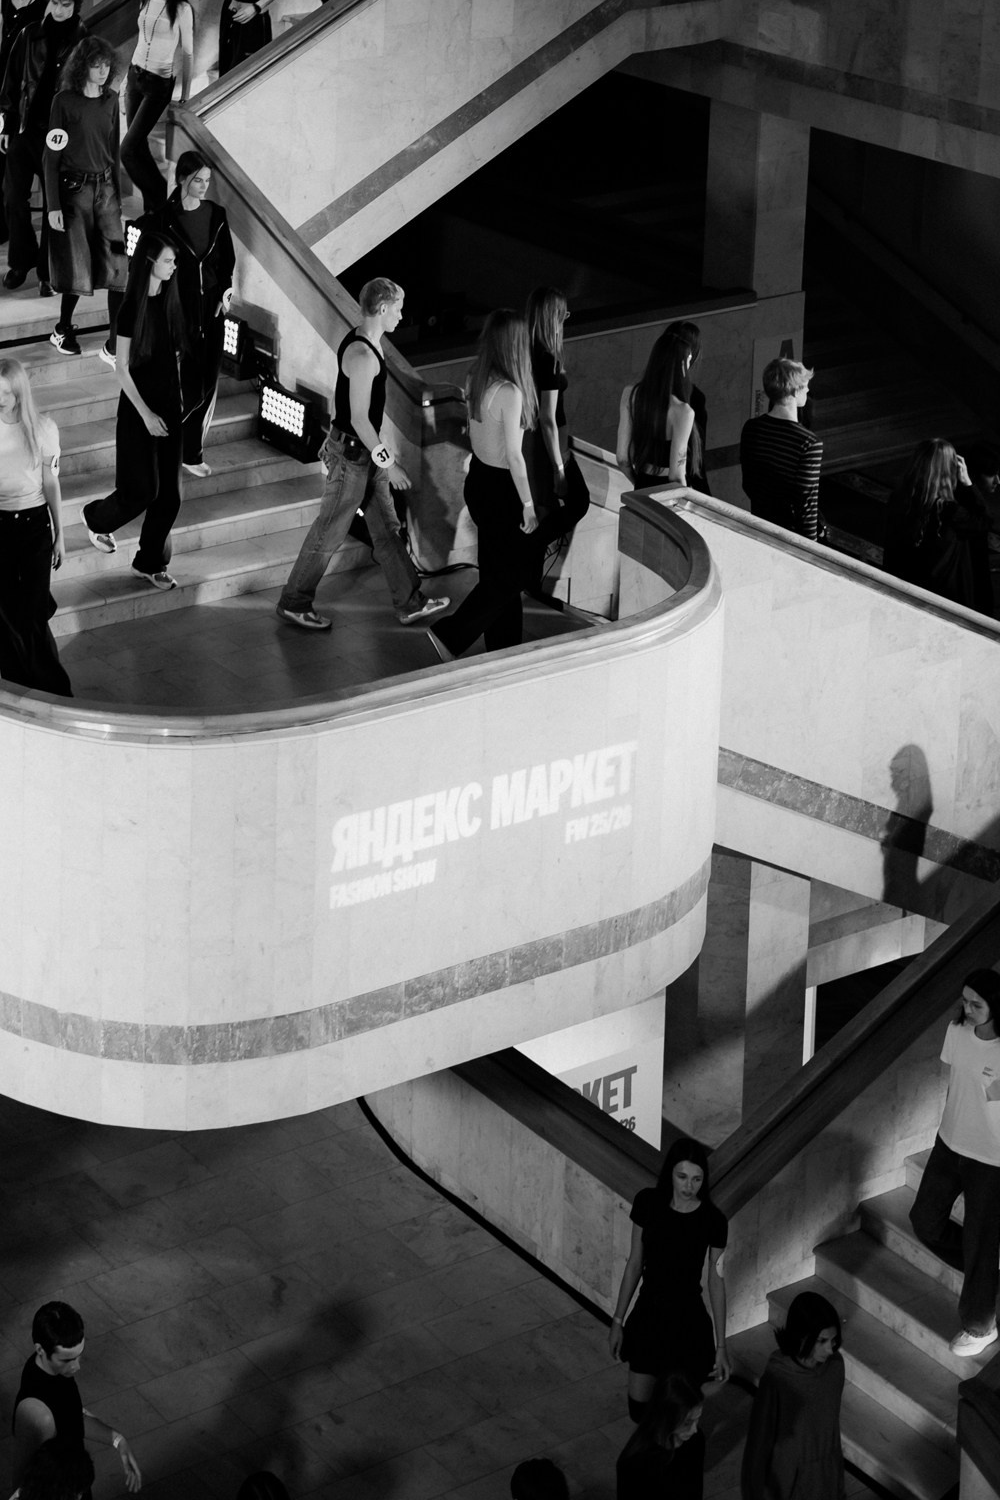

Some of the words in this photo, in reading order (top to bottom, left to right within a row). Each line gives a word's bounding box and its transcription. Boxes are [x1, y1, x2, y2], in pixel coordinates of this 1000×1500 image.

[51, 134, 64, 145] 47
[376, 447, 391, 463] 37
[330, 781, 484, 873] ЯНДЕКС
[490, 740, 639, 830] МАРКЕТ
[329, 871, 393, 910] FASHION
[392, 858, 438, 893] SHOW
